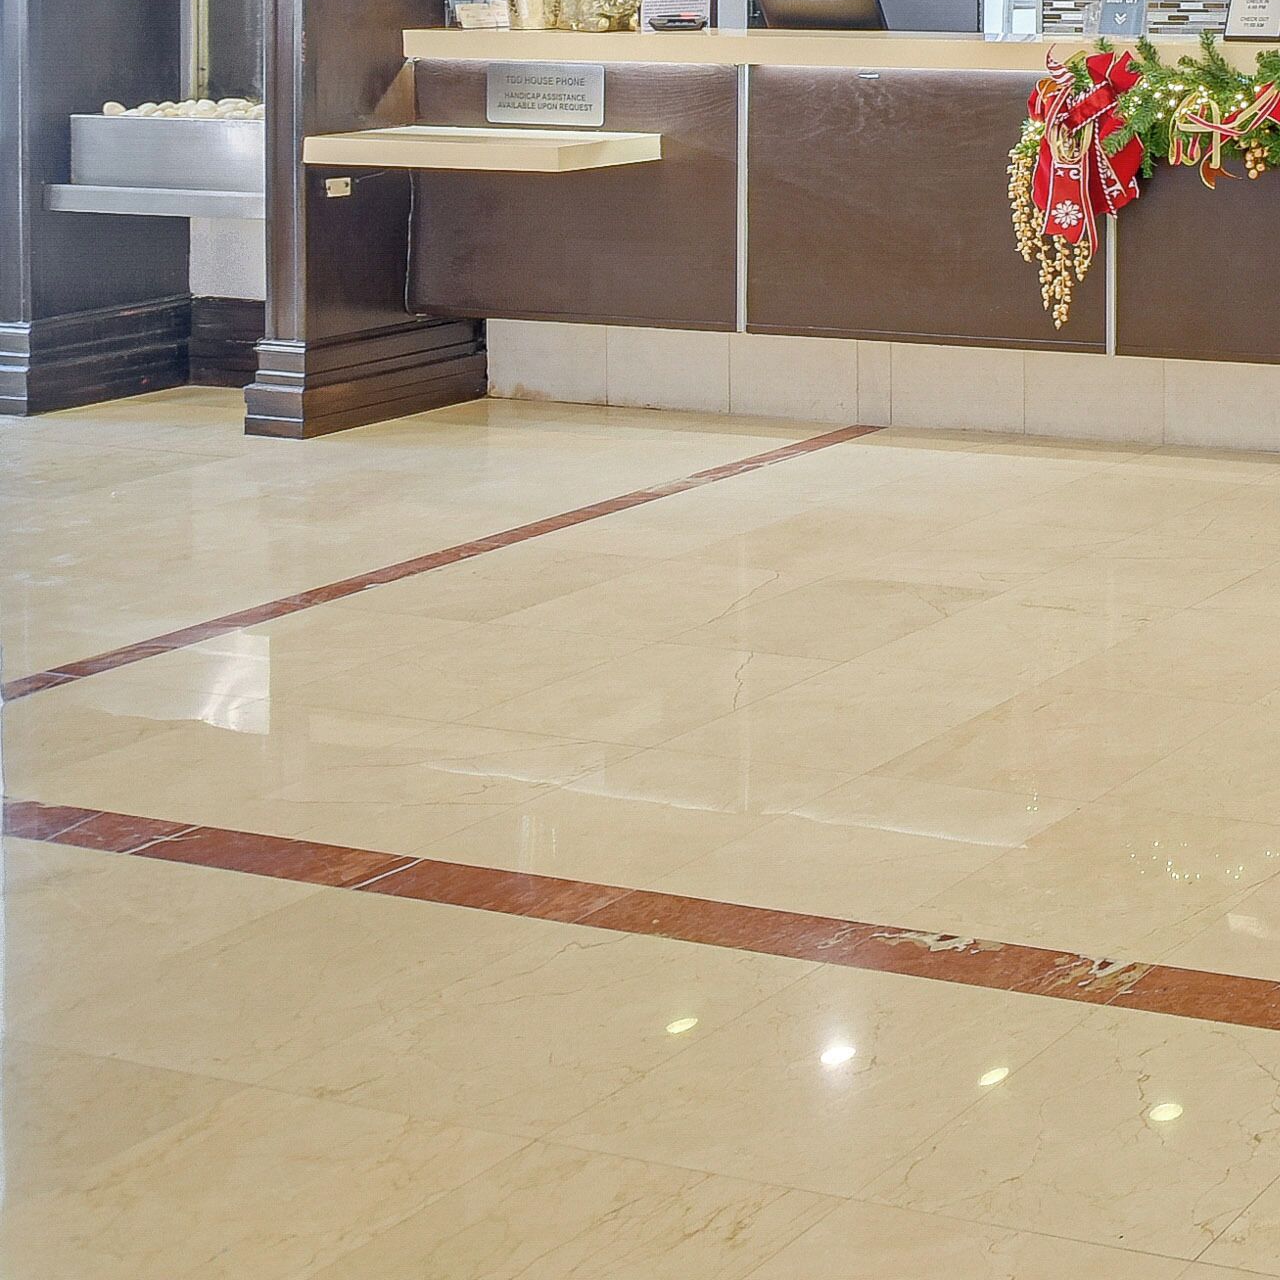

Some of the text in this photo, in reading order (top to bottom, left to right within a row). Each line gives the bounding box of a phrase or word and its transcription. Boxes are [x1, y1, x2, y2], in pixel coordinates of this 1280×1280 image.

[524, 75, 553, 86] HOUSE
[555, 77, 585, 87] PHONE
[504, 92, 586, 102] HANDICAP ASSISTANCE
[497, 102, 593, 112] AVAILABLE UPON REQUEST
